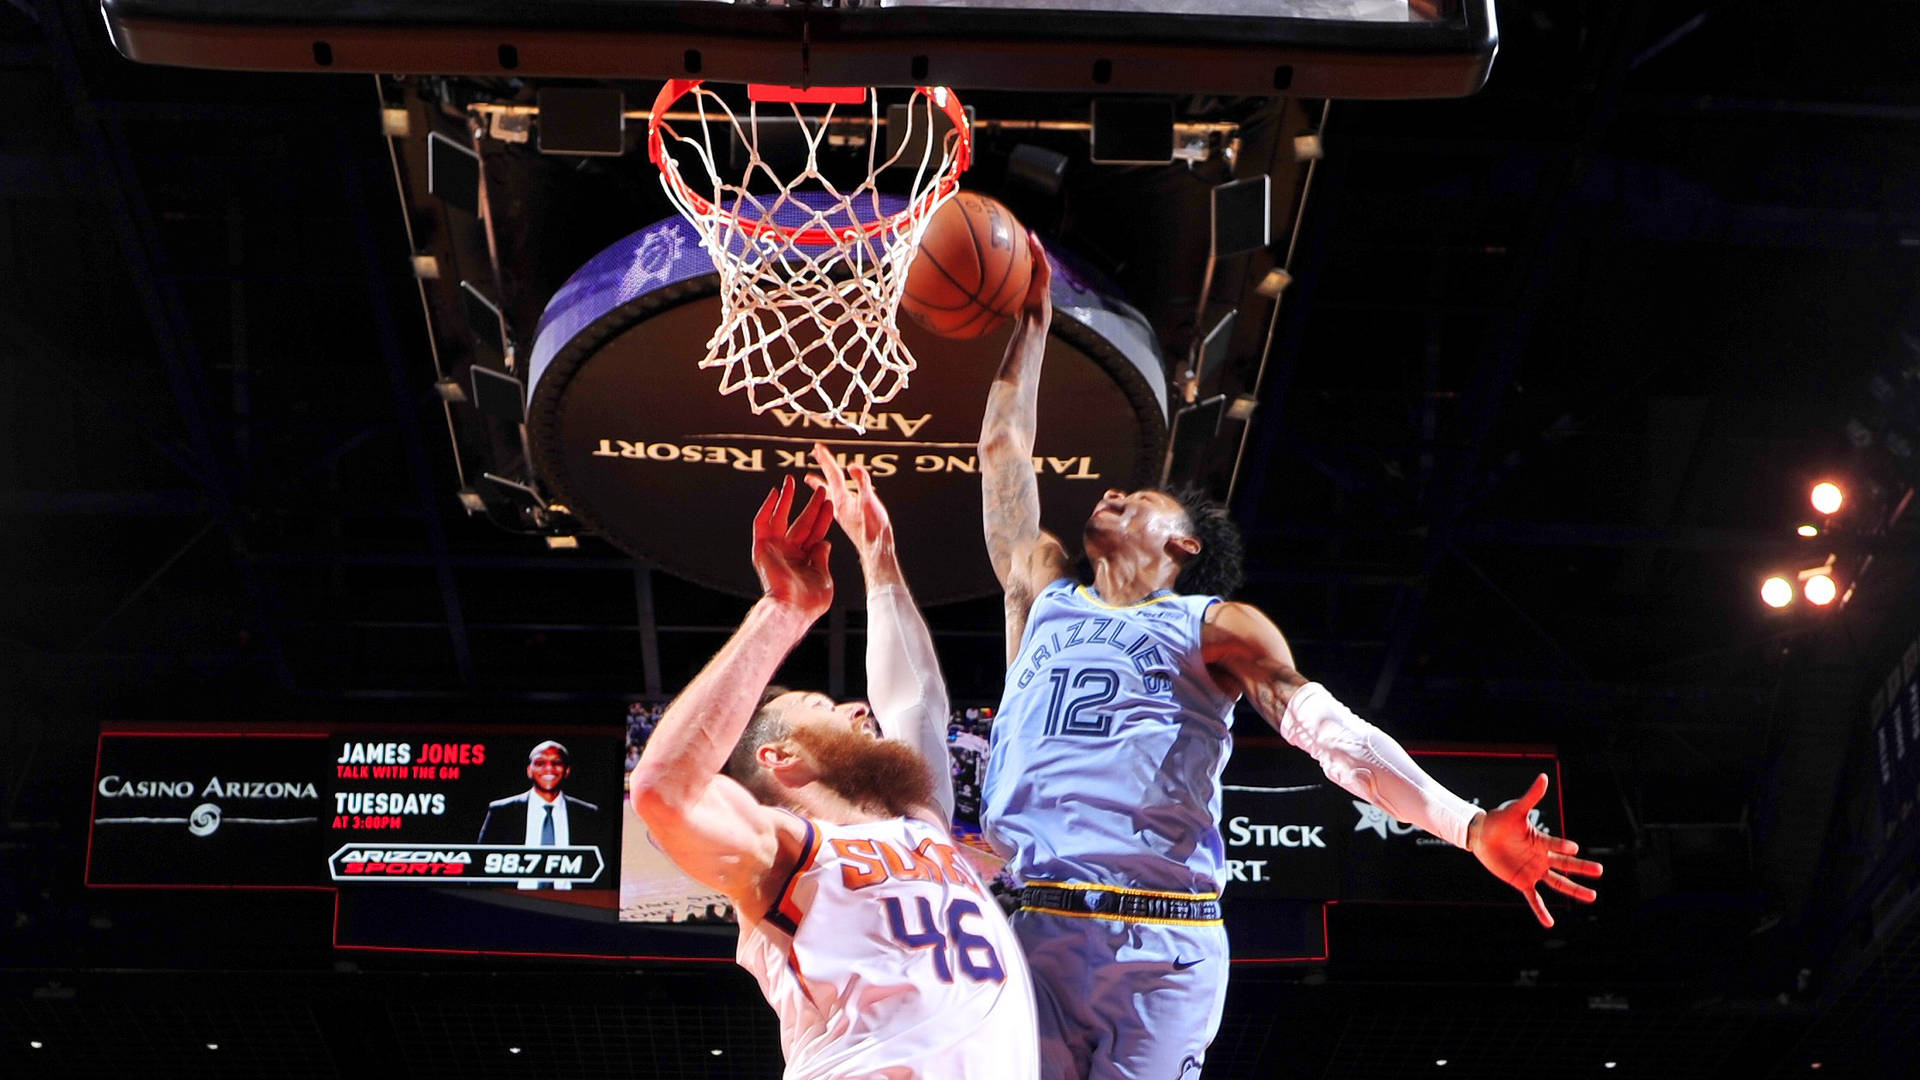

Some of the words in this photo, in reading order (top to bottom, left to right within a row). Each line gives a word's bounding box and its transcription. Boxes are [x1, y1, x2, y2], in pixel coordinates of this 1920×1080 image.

[592, 439, 766, 472] RESORT
[1016, 618, 1173, 694] GRIZZLIES
[1043, 668, 1120, 738] 12
[337, 742, 411, 765] JAMES
[416, 743, 486, 765] JONES
[337, 765, 370, 779] TALK
[373, 766, 409, 780] WITH
[412, 766, 436, 780] THE
[439, 766, 460, 780] GM
[98, 775, 194, 798] CASINO
[201, 776, 319, 799] ARIZONA
[334, 792, 446, 815] TUESDAYS
[332, 815, 349, 829] AT
[352, 815, 402, 830] 3:00PM
[1228, 816, 1327, 848] STICK
[341, 850, 472, 864] ARIZONA
[344, 862, 464, 875] SPORTS
[484, 853, 542, 874] 98.7
[545, 855, 583, 875] FM
[876, 896, 1007, 984] 46
